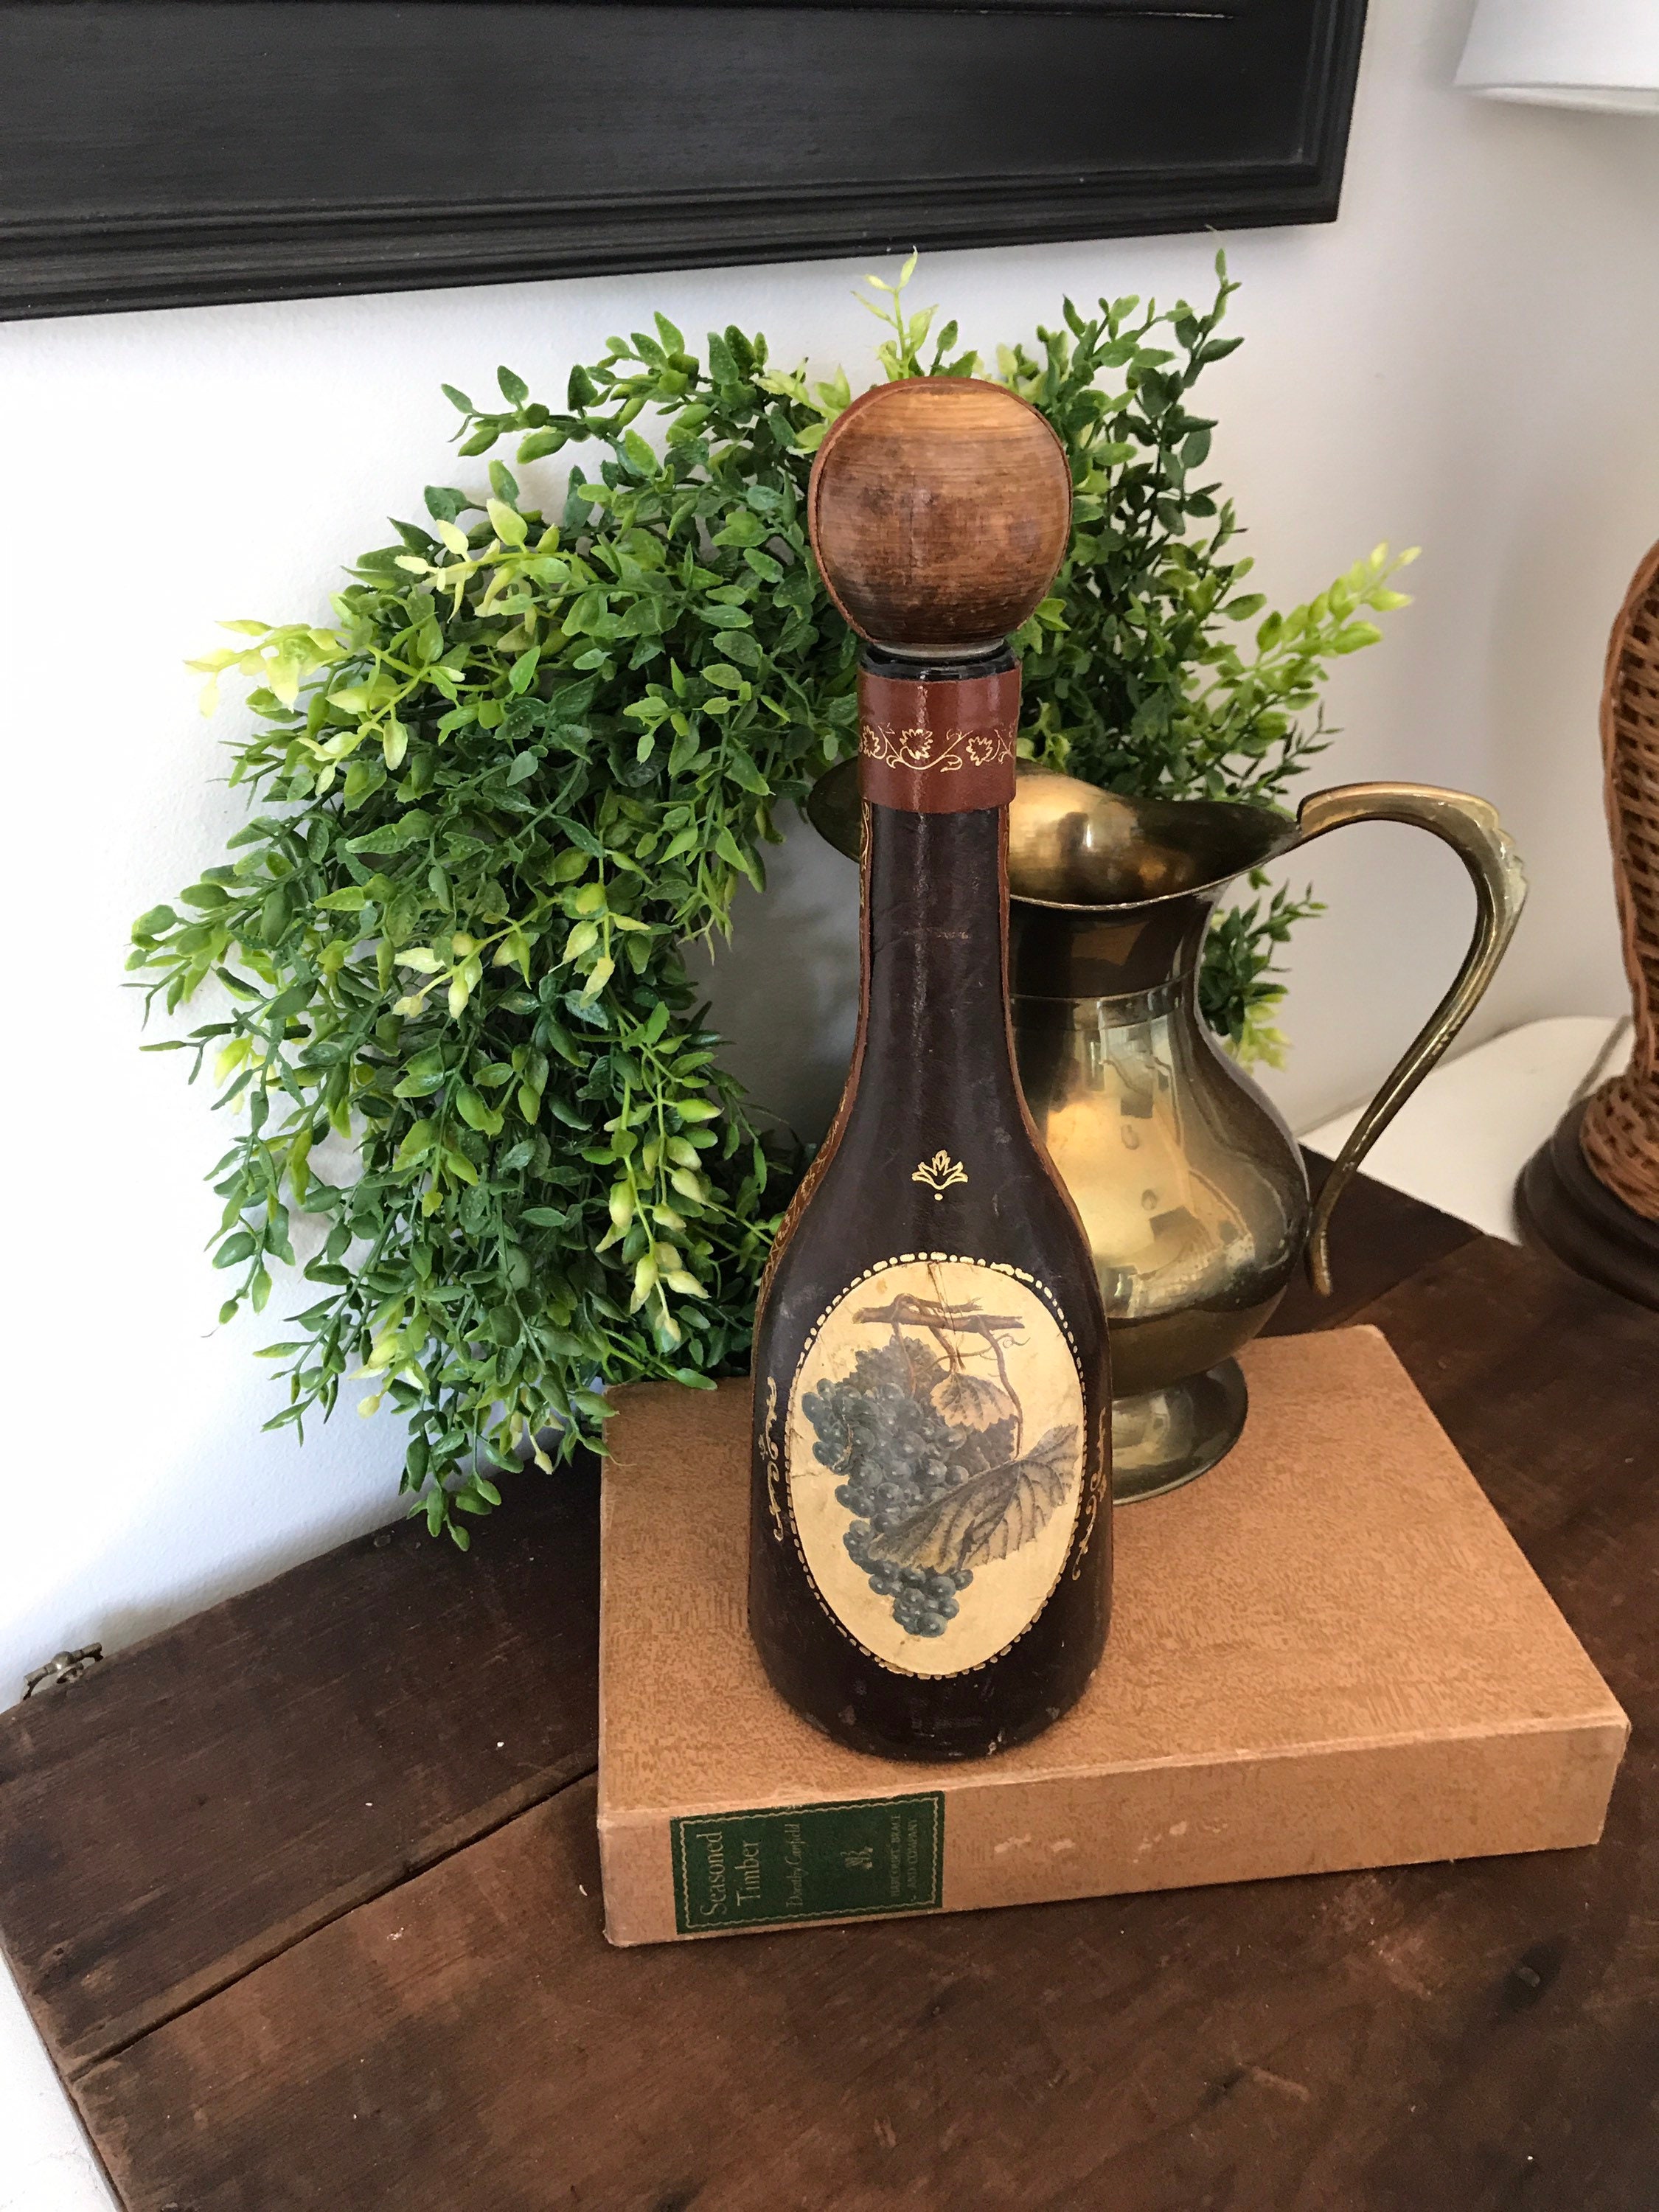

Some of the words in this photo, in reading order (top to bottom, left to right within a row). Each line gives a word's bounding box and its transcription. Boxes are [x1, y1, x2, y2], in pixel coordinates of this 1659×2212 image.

[785, 1823, 810, 1865] Canfield
[905, 1818, 918, 1865] COMPANY
[696, 1830, 726, 1916] Seasoned
[734, 1840, 761, 1907] Timber
[906, 1867, 918, 1890] AND
